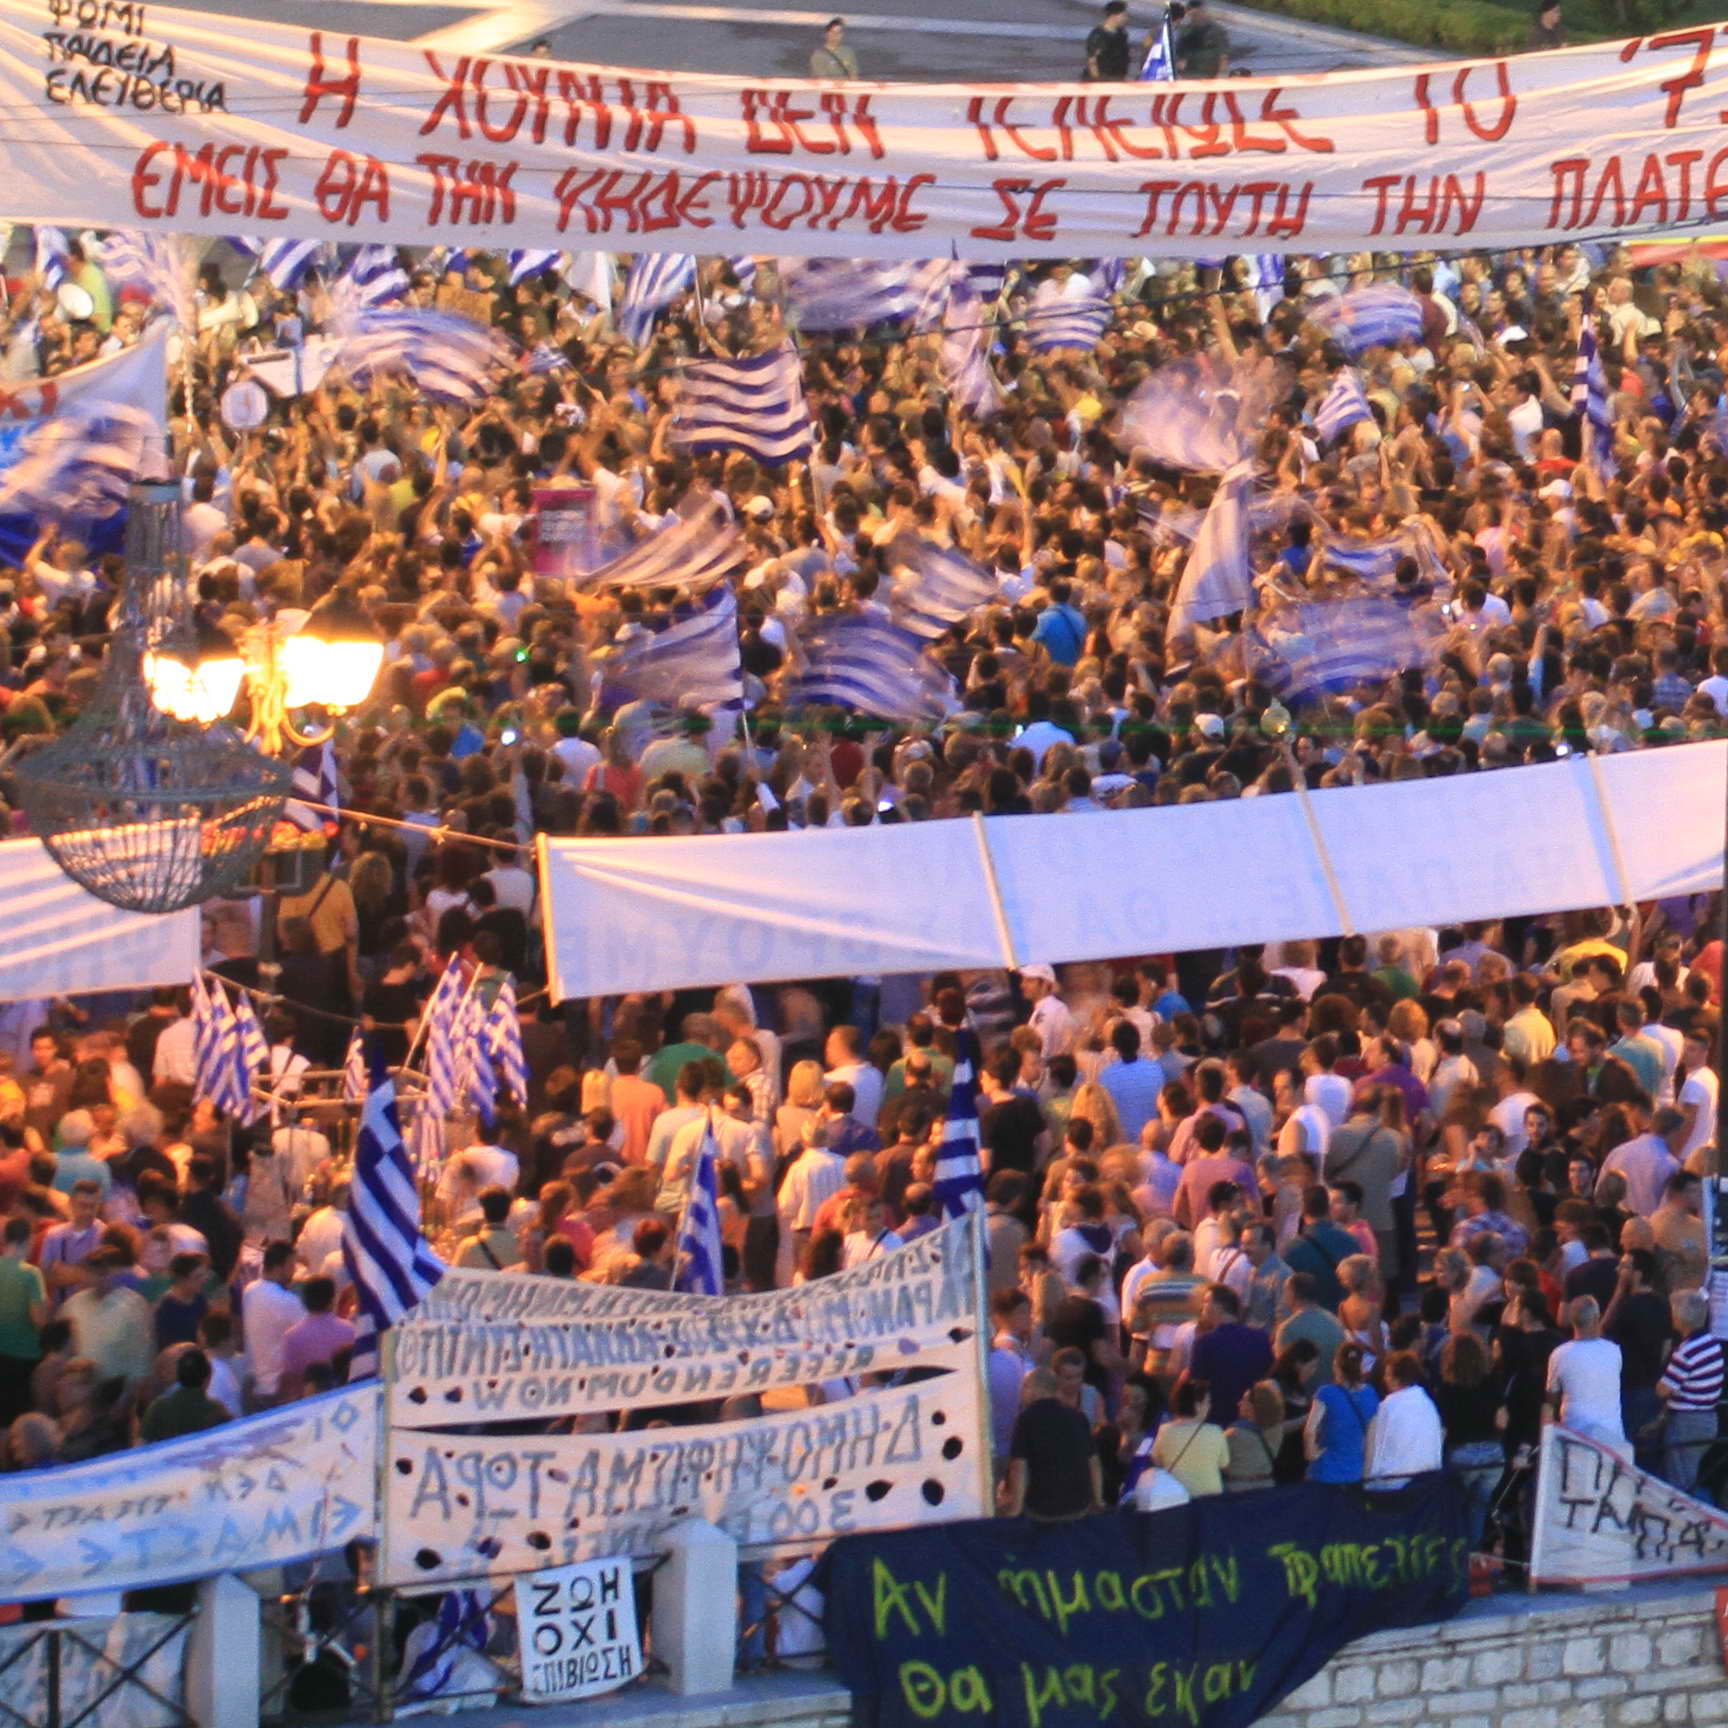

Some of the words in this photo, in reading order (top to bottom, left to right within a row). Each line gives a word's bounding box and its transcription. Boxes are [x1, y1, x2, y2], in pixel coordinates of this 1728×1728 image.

[297, 31, 361, 129] Η
[130, 141, 290, 220] ΕΜΕΙΣ
[313, 150, 390, 226] ΘΑ
[415, 152, 519, 227] ΤΗΝ
[553, 167, 937, 235] ΚΗΔΕΨΟΥΜΕ
[969, 174, 1068, 242] ΣΕ
[1362, 170, 1487, 238] ΤΗΝ
[531, 1567, 620, 1617] ΖΩΗ
[872, 1558, 950, 1640] Αν
[534, 1608, 617, 1656] ΟΧΙ
[533, 1645, 633, 1696] ΕΠΙΒΙΩΣΗ
[899, 1661, 993, 1720] Θα
[1021, 1662, 1120, 1728] μας
